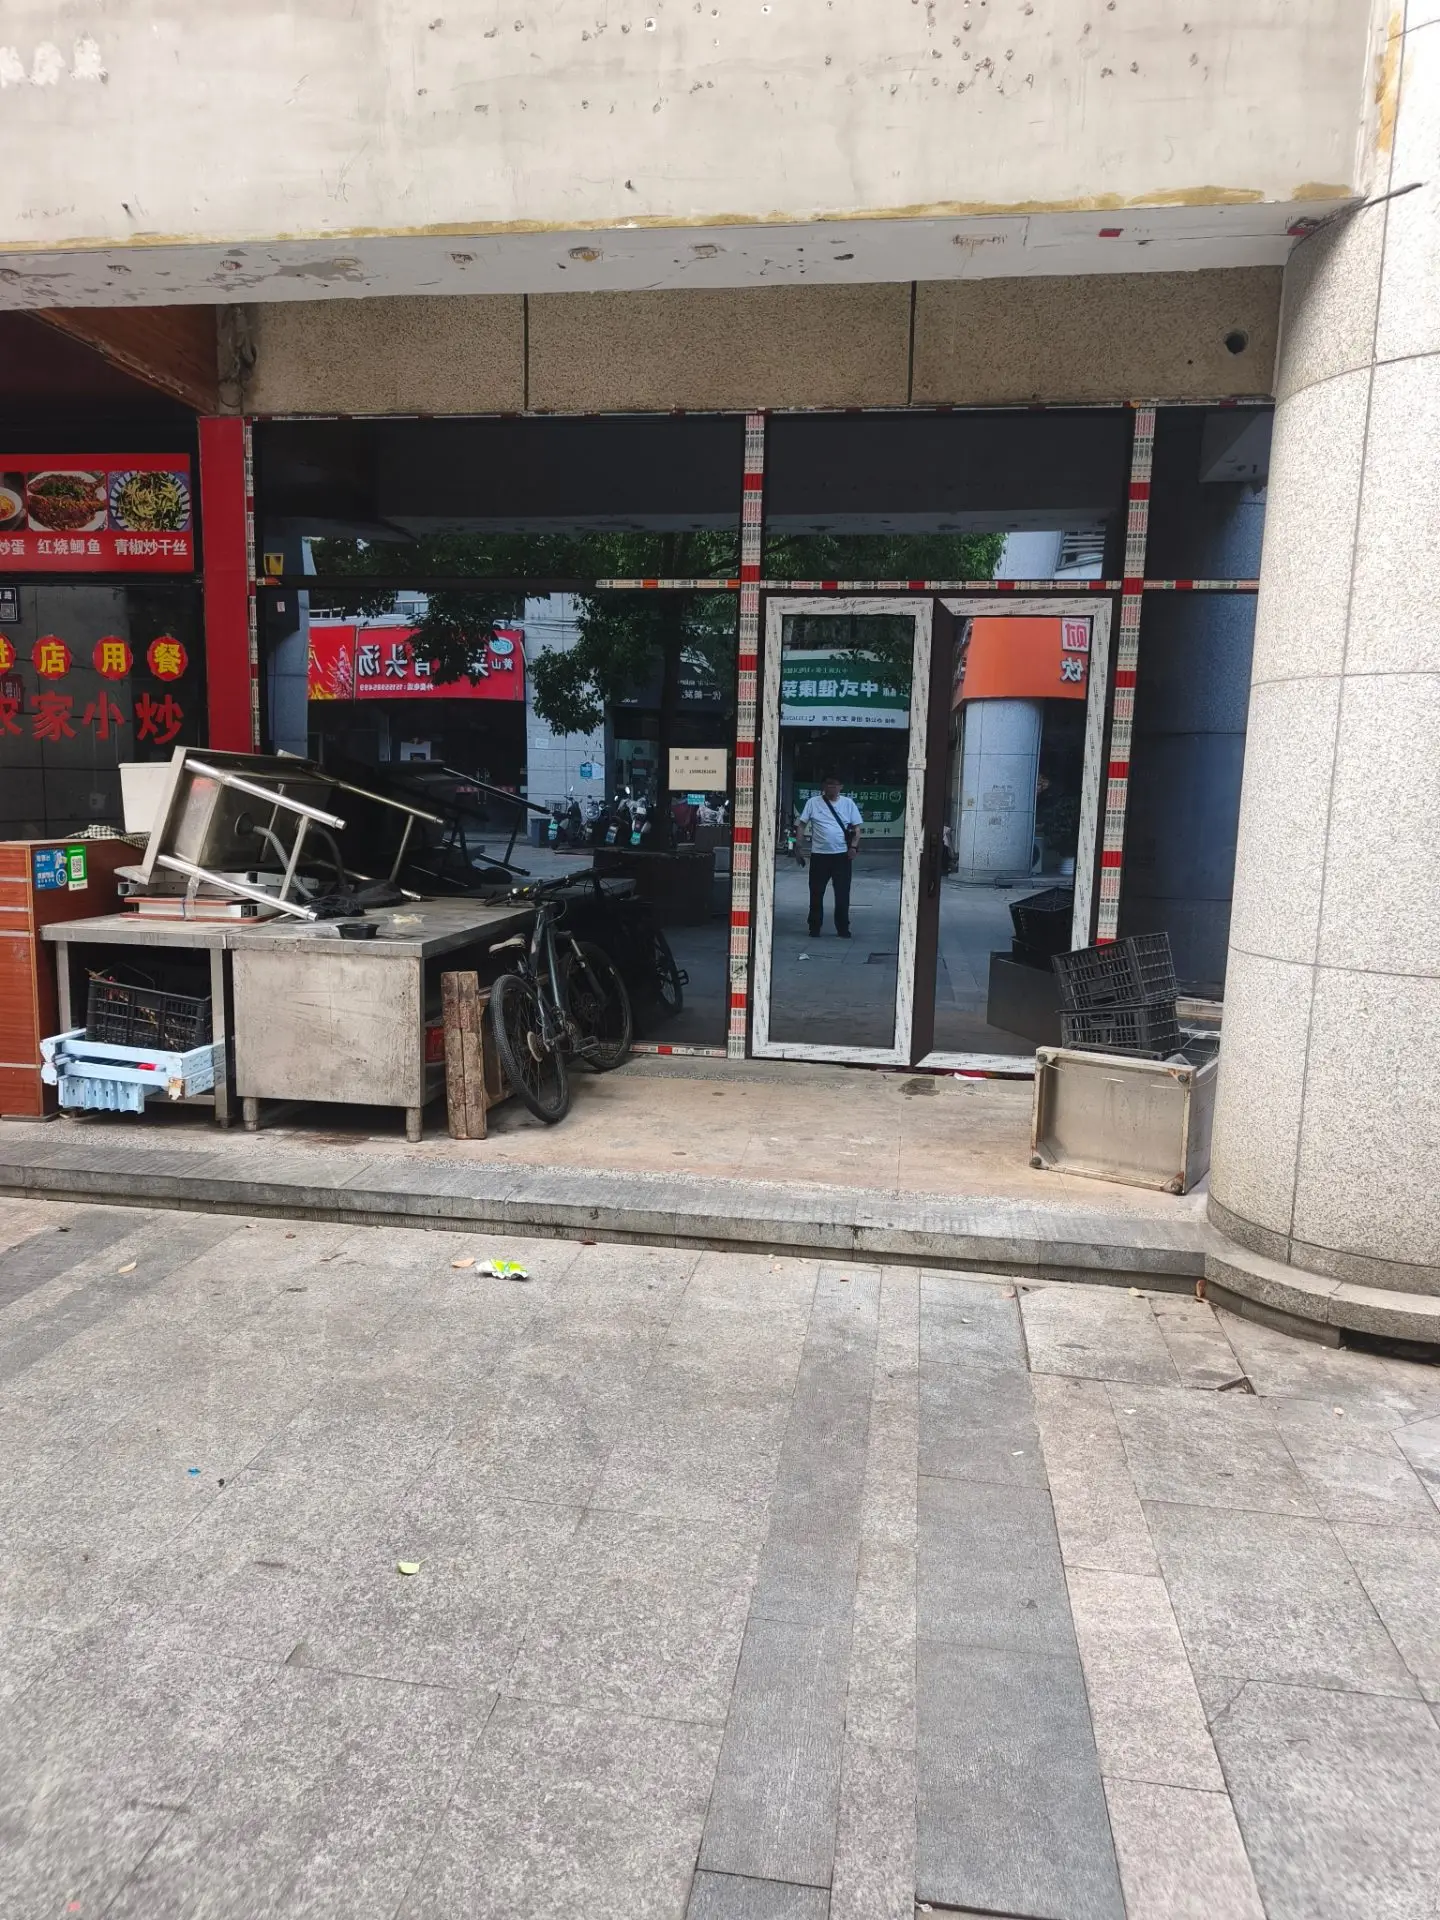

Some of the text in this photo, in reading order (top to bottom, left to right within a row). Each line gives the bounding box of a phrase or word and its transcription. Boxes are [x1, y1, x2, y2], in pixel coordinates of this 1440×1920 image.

[37, 538, 102, 556] 红烧鲫鱼
[114, 538, 188, 557] 青椒炒干丝
